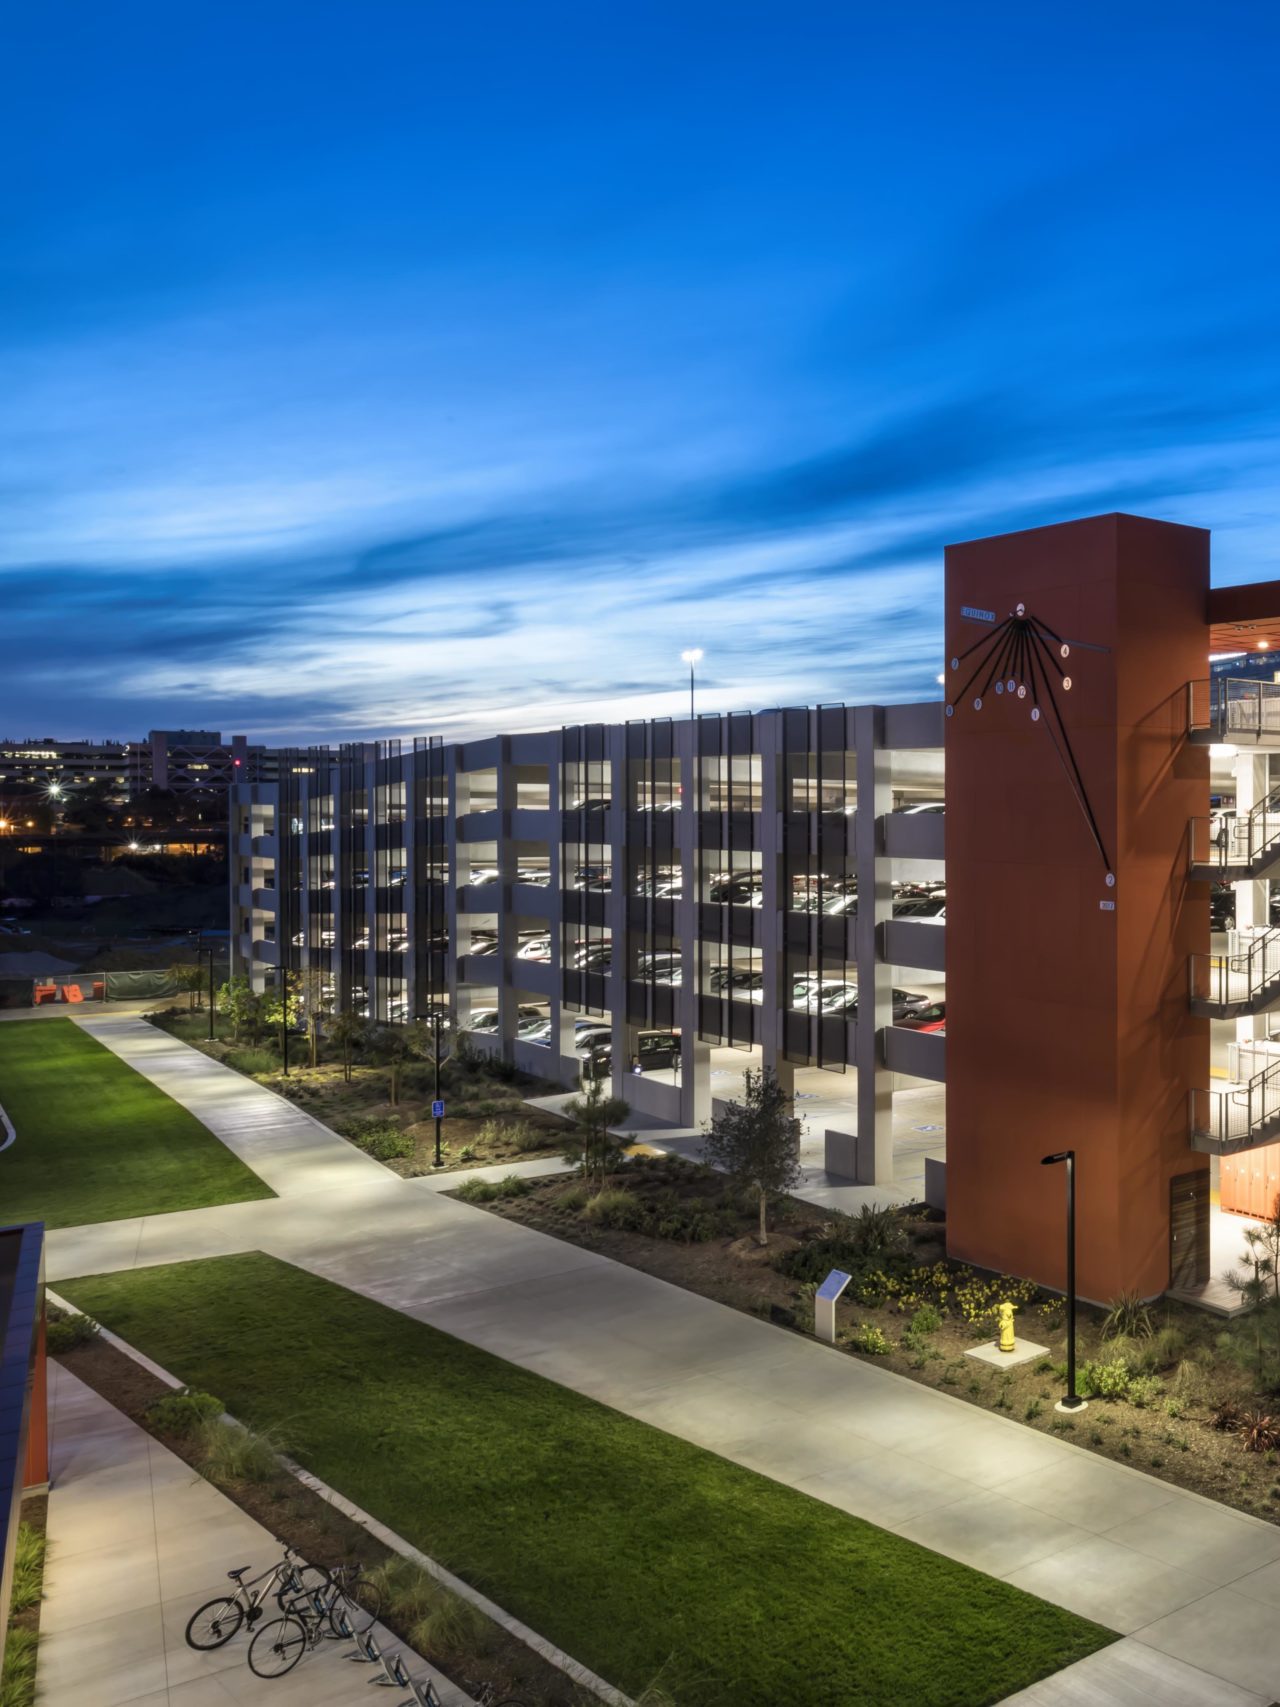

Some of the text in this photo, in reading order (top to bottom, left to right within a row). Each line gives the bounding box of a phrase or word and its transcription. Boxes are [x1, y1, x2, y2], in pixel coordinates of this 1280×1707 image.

[1063, 647, 1068, 655] 4
[1008, 682, 1014, 691] 11
[1065, 679, 1070, 688] 3
[1019, 687, 1024, 697] 12
